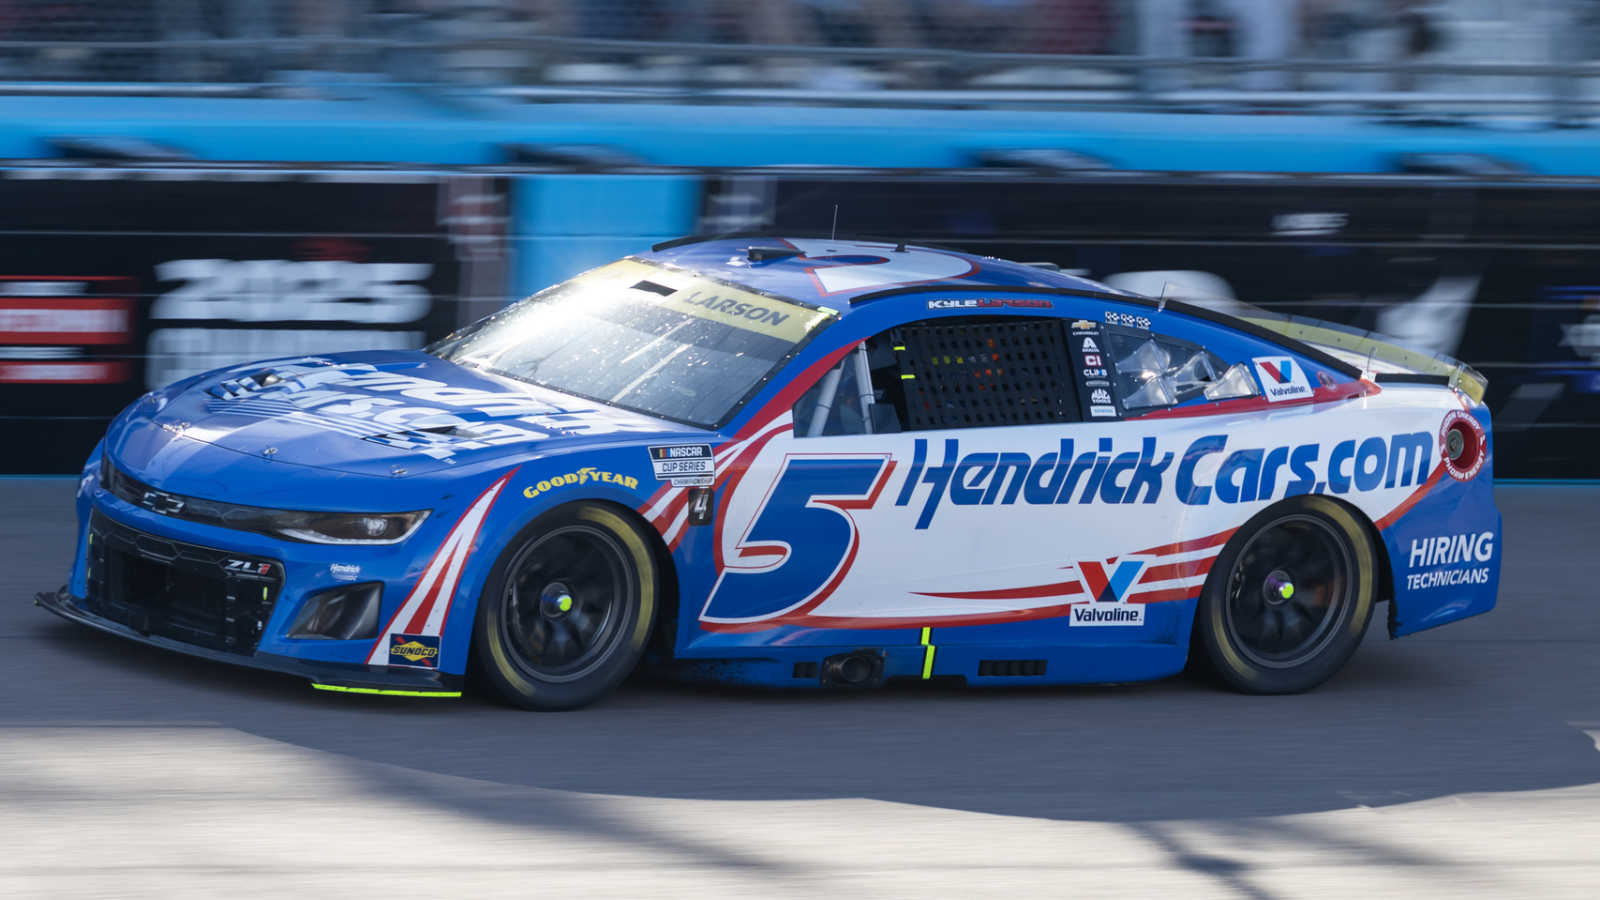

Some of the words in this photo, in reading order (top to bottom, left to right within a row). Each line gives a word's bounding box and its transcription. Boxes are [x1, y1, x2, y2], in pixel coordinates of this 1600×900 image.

[682, 291, 791, 327] LARSON
[1270, 386, 1305, 396] Valvoline
[670, 446, 703, 457] NASCAR
[662, 462, 678, 472] CUP
[679, 461, 706, 471] SERIES
[694, 494, 709, 520] 4
[698, 453, 896, 627] 5
[1409, 531, 1494, 568] HIRING
[225, 559, 271, 574] ZL1
[330, 563, 361, 573] Hendrick
[1407, 567, 1489, 590] TECHNICIANS
[1074, 608, 1139, 622] Valvoline
[393, 646, 436, 657] SUNOCO
